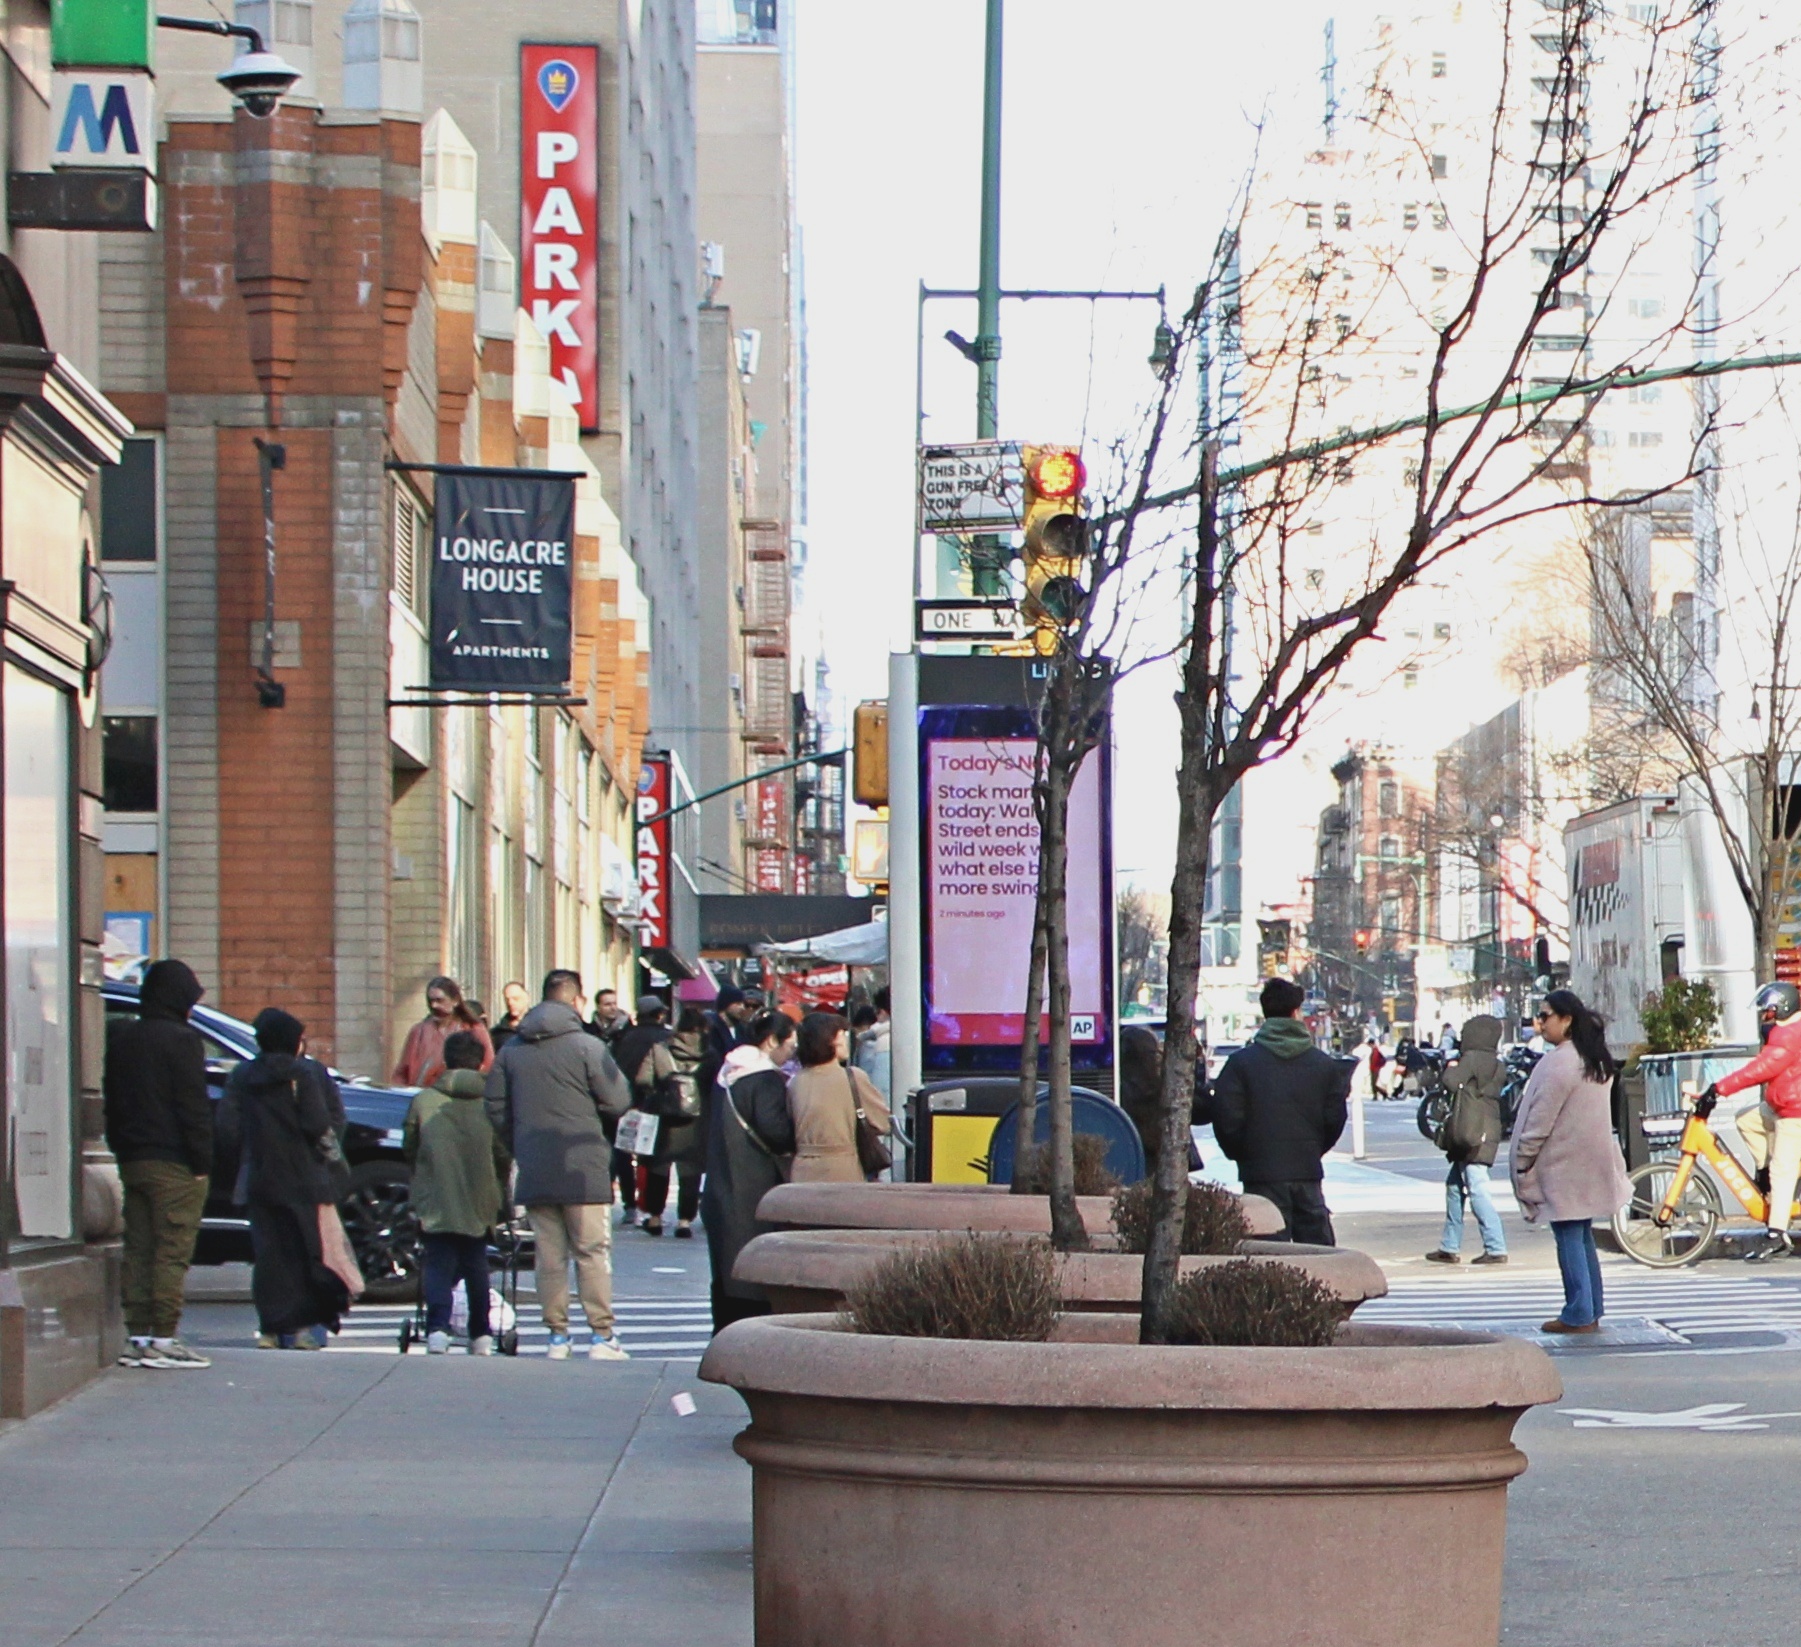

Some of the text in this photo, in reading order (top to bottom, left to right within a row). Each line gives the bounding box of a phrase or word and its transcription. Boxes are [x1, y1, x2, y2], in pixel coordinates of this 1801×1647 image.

[56, 84, 140, 154] M
[532, 131, 584, 346] PARK
[927, 465, 982, 476] THIS IS A
[926, 482, 953, 493] GUN
[440, 537, 566, 565] LONGACRE
[462, 567, 543, 594] HOUSE
[934, 612, 972, 628] ONE
[453, 645, 549, 659] APARTMENTS
[938, 755, 1013, 775] Today's
[938, 785, 1033, 799] Stock mar
[938, 804, 1035, 822] today: Wal
[939, 823, 1039, 837] Street ends
[939, 842, 974, 856] wild
[979, 842, 1026, 856] week
[637, 796, 661, 918] PARK
[939, 861, 985, 875] what
[989, 861, 1024, 875] else
[939, 880, 1040, 897] more swin
[946, 910, 984, 918] minutes
[986, 911, 1005, 920] ago
[1073, 1022, 1092, 1034] AP
